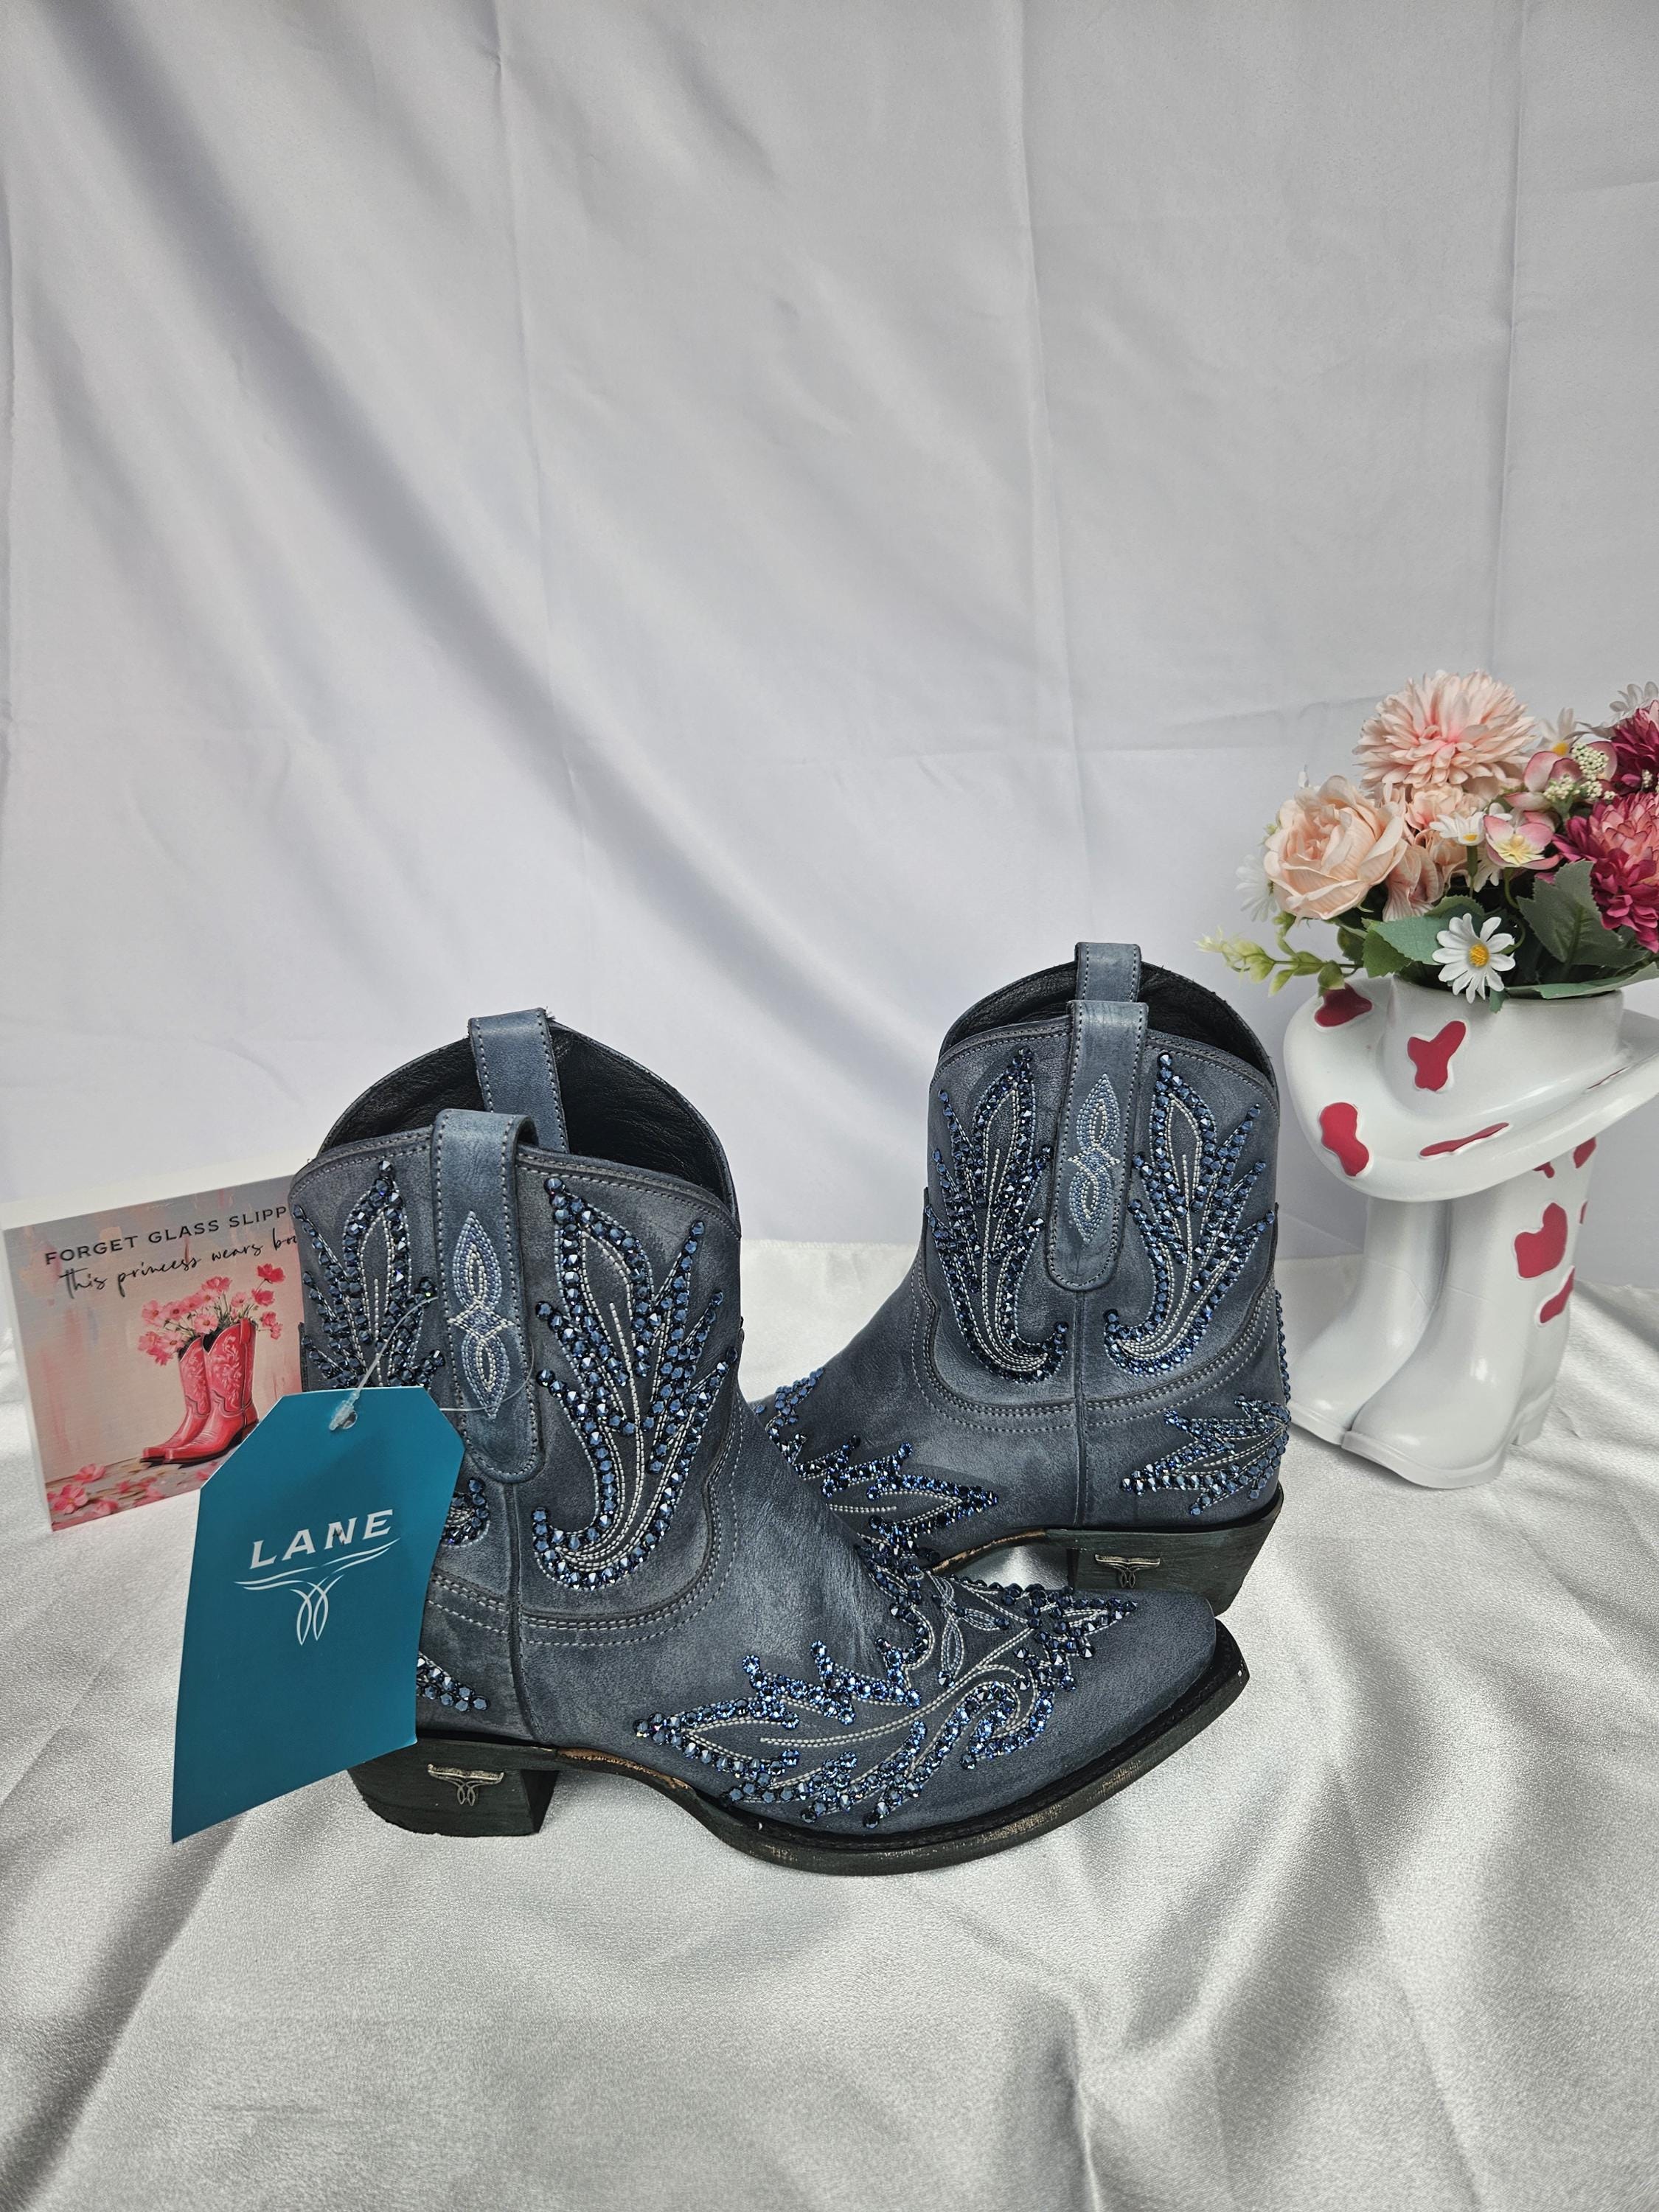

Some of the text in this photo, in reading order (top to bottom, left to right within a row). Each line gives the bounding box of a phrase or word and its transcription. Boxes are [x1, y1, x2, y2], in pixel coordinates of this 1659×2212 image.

[45, 1235, 139, 1265] FORGET
[148, 1220, 219, 1244] GLASS
[59, 1267, 107, 1299] this
[116, 1257, 201, 1297] princess
[212, 1243, 263, 1262] wears
[249, 1509, 393, 1570] LANE
